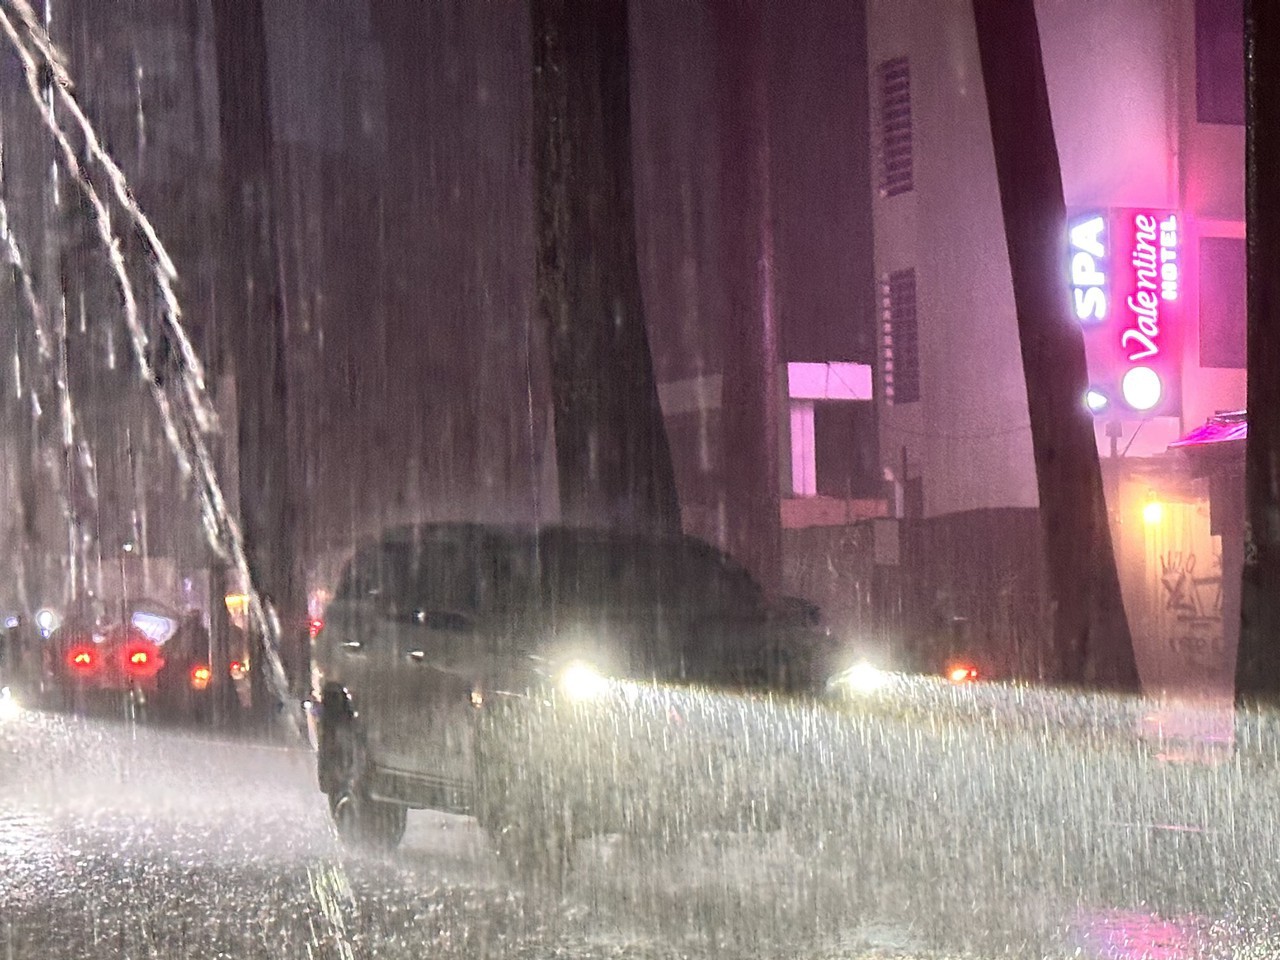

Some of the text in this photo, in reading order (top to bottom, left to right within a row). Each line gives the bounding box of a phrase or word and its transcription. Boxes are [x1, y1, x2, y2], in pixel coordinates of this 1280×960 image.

[1071, 216, 1107, 320] SPA
[1122, 213, 1159, 361] Valentine
[1160, 214, 1178, 300] HOTEL
